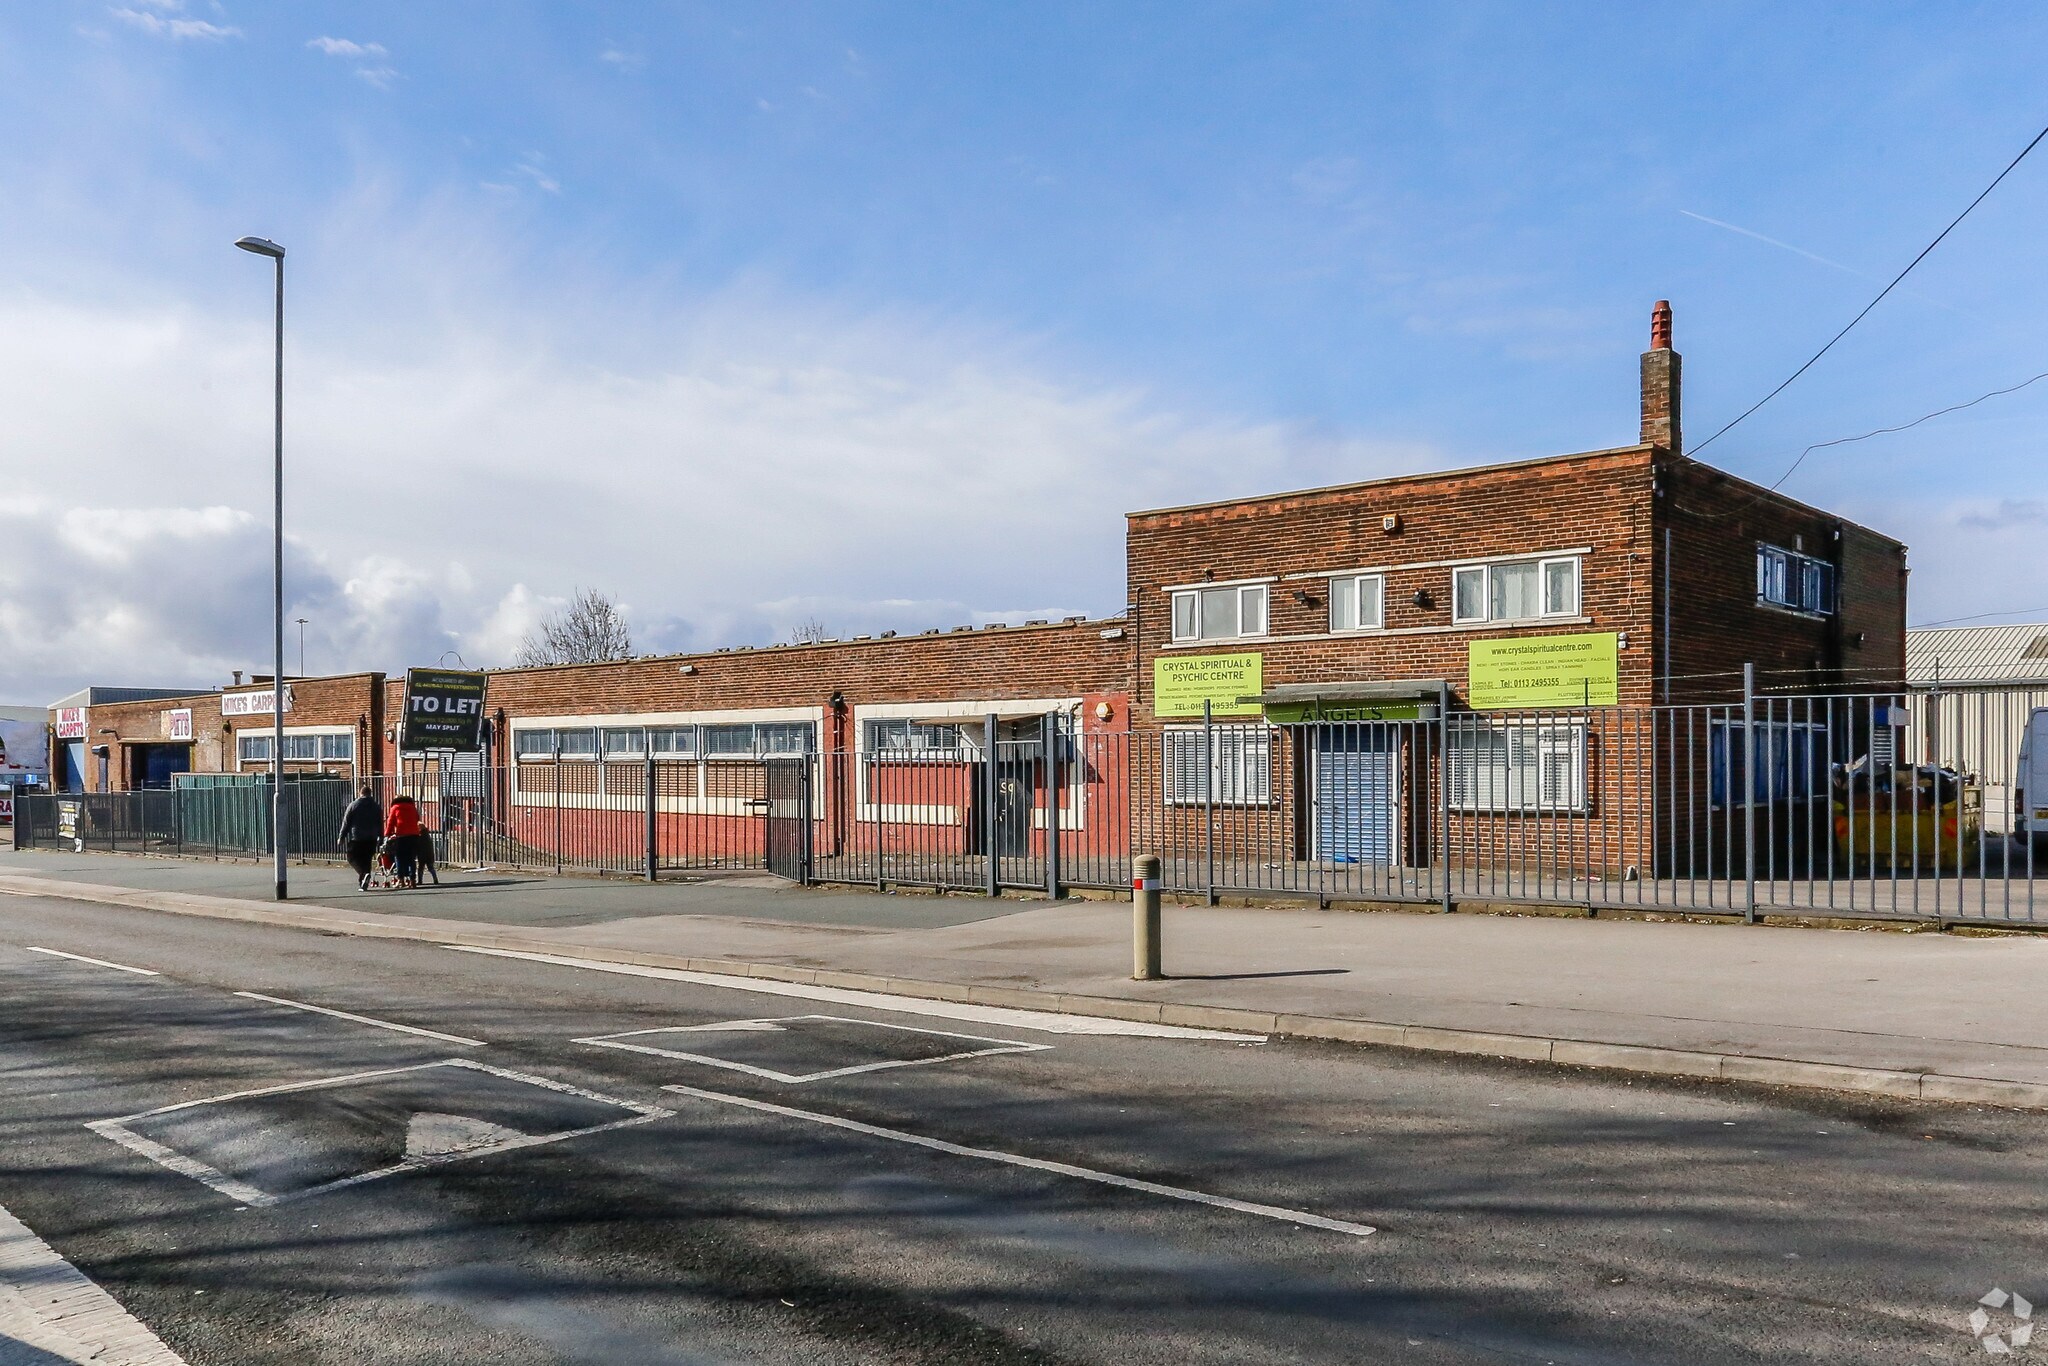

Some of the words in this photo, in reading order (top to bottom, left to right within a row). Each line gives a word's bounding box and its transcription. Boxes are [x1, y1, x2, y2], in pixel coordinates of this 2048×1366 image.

[1491, 642, 1592, 656] www.crystalspiritualcentre.com
[1163, 661, 1199, 672] CRYSTAL
[1201, 659, 1243, 670] SPIRITUAL
[1246, 659, 1252, 668] &
[1173, 672, 1209, 682] PSYCHIC
[1211, 671, 1244, 680] CENTRE
[1501, 679, 1512, 688] Tel:
[1514, 679, 1530, 688] 0113
[1531, 678, 1560, 687] 2495355
[224, 696, 248, 713] MIKE'S
[411, 695, 439, 713] TO
[445, 697, 481, 714] LET
[62, 707, 80, 722] MIKE'S
[1299, 706, 1383, 722] ANGELS
[59, 722, 84, 737] CARPETS
